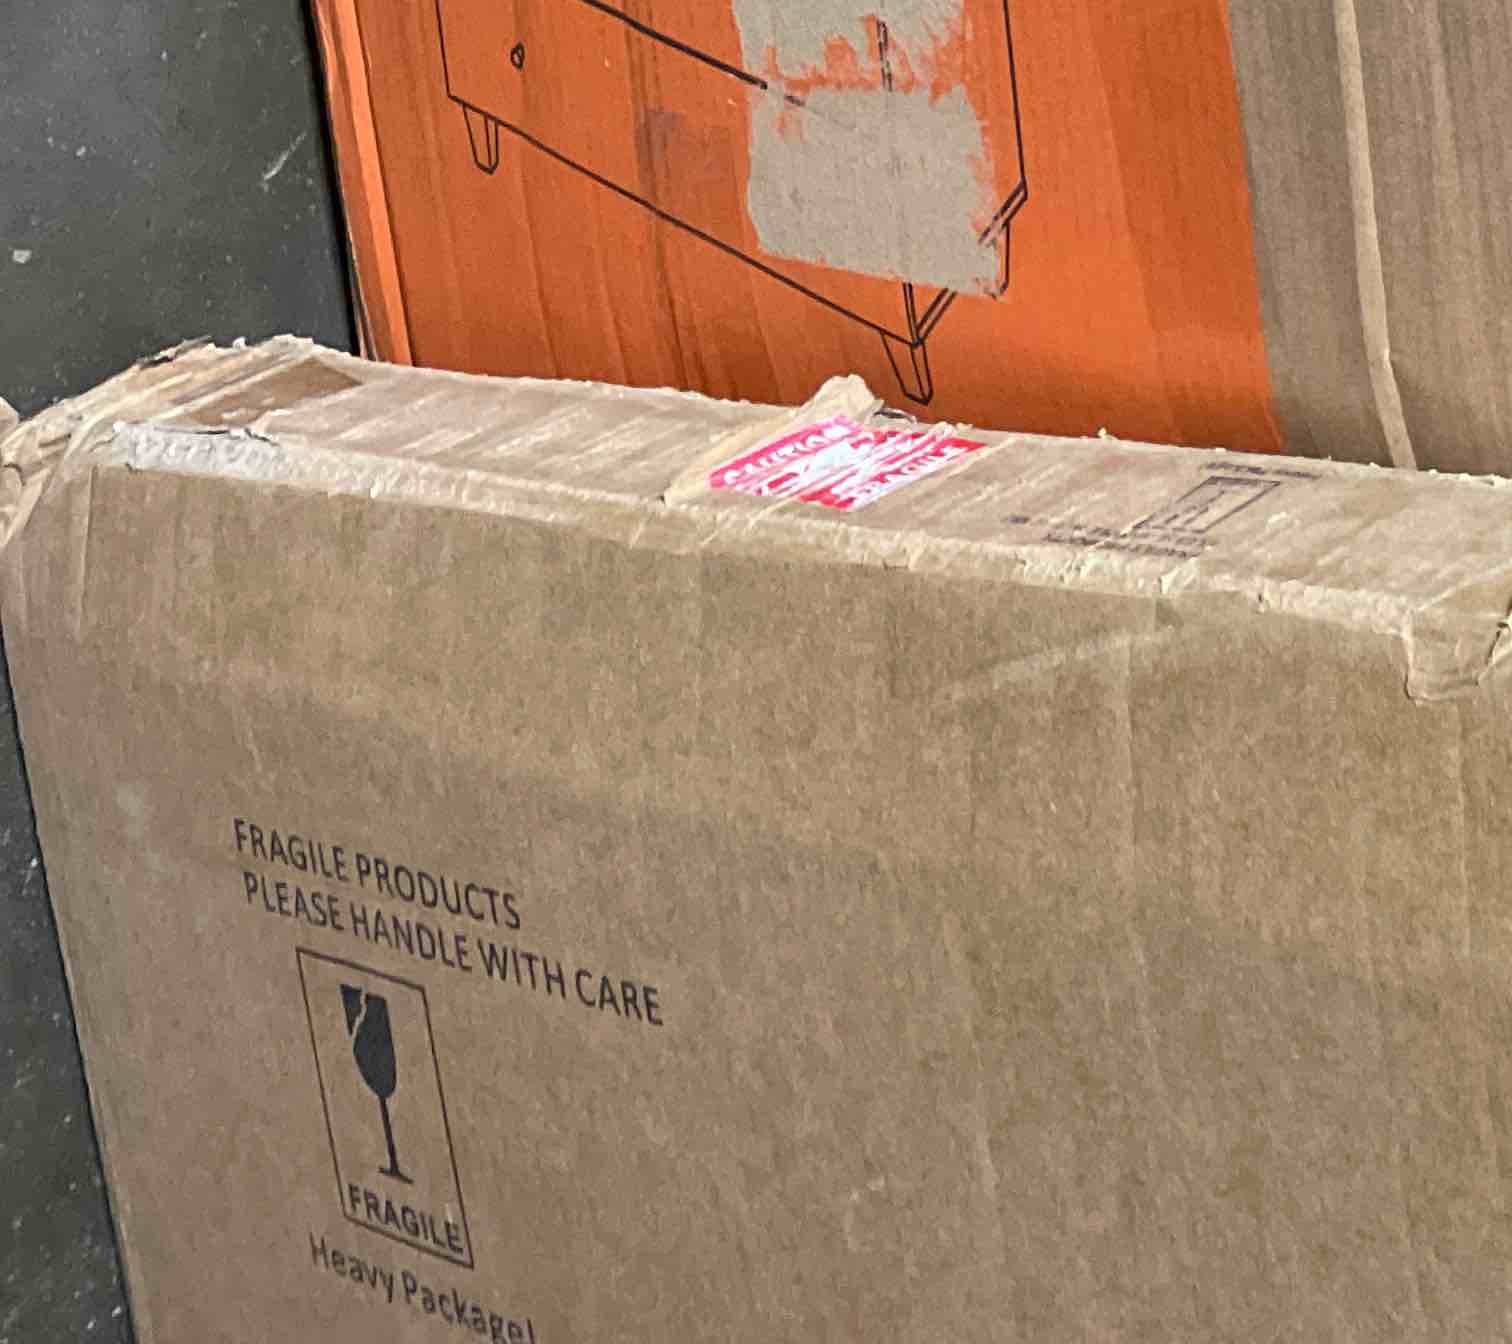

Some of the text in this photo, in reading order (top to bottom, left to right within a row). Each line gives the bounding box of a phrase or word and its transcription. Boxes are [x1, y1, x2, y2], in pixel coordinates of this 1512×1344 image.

[234, 816, 522, 931] FRAGILE PRODUCTS
[242, 870, 665, 1028] PLEASE HANDLE WITH CARE
[348, 1183, 465, 1256] FRAGILE
[308, 1233, 397, 1305] Heavy
